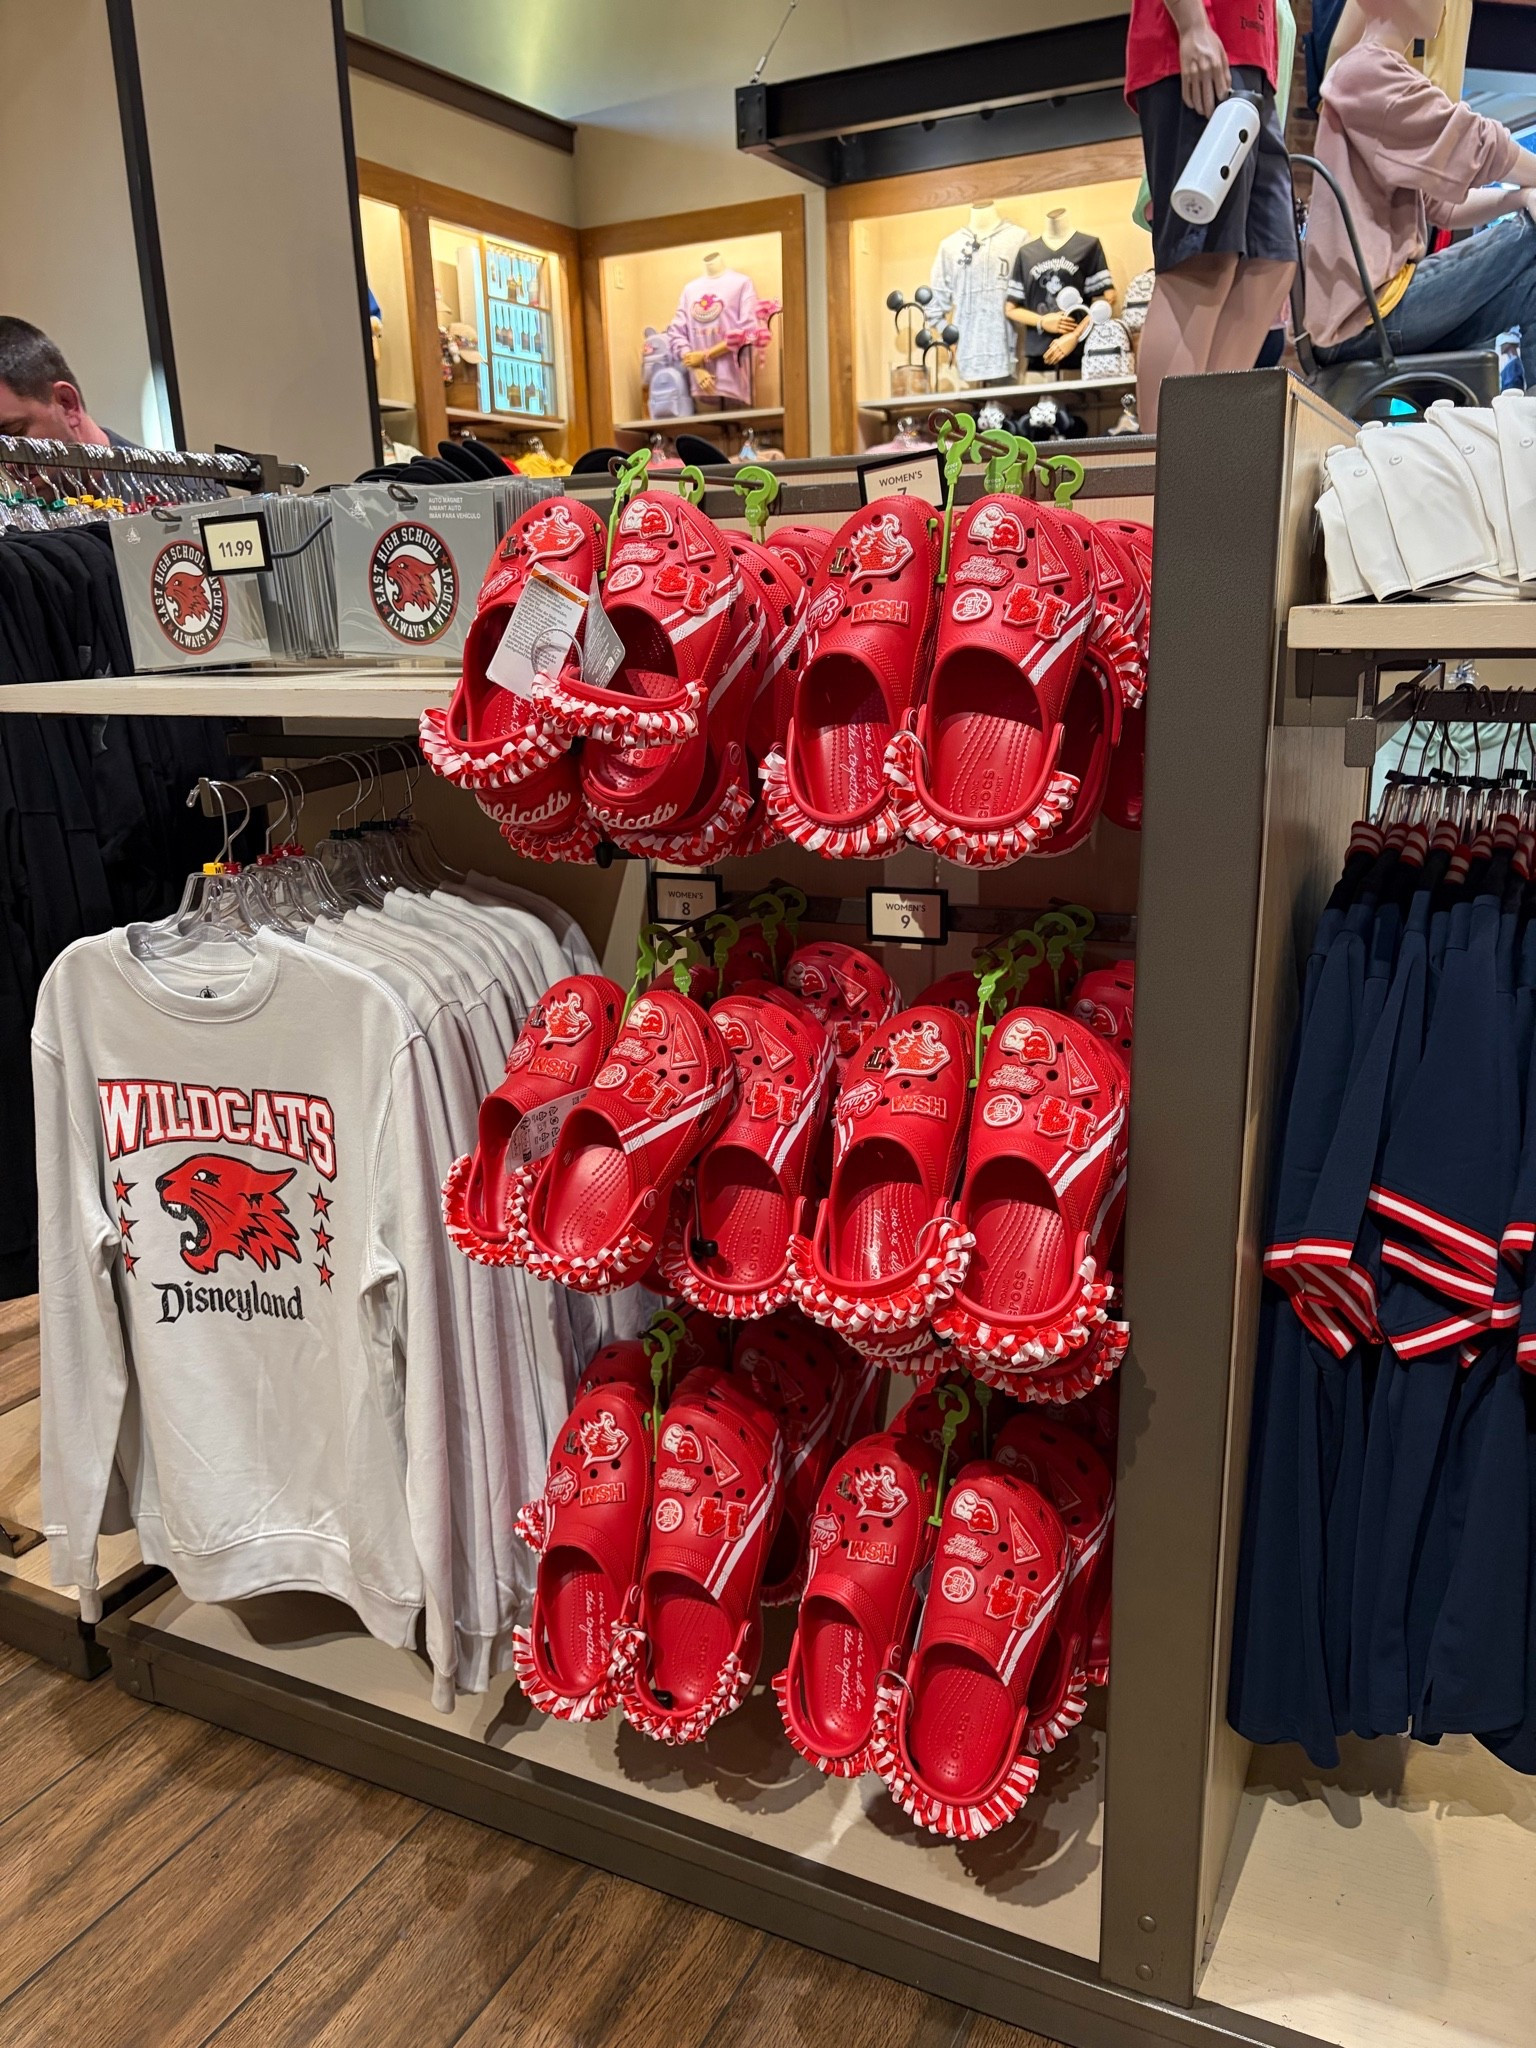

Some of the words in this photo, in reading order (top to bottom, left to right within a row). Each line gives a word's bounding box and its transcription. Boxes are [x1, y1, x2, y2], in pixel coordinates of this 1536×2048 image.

[1030, 256, 1080, 280] Disneyland
[879, 470, 923, 487] WOMEN'S
[169, 544, 206, 569] SCHOOL
[218, 539, 254, 558] 11.99
[376, 531, 400, 563] HIGH
[400, 526, 442, 559] SCHOOL
[154, 557, 171, 585] HIGH
[372, 563, 387, 605] EAST
[154, 587, 169, 625] EAST
[386, 612, 426, 638] ALWAYS
[427, 620, 435, 634] A
[434, 567, 454, 626] WILDCAT
[172, 628, 207, 648] ALWAYS
[206, 628, 214, 638] A
[475, 791, 571, 826] ildcats
[581, 793, 677, 830] ildcats
[668, 890, 704, 899] WOMEN'S
[682, 902, 690, 915] 8
[886, 903, 926, 912] WOMEN'S
[901, 915, 910, 929] 9
[97, 1078, 338, 1183] WILDCATS
[152, 1280, 305, 1325] Disneyland
[698, 1497, 748, 1541] 14
